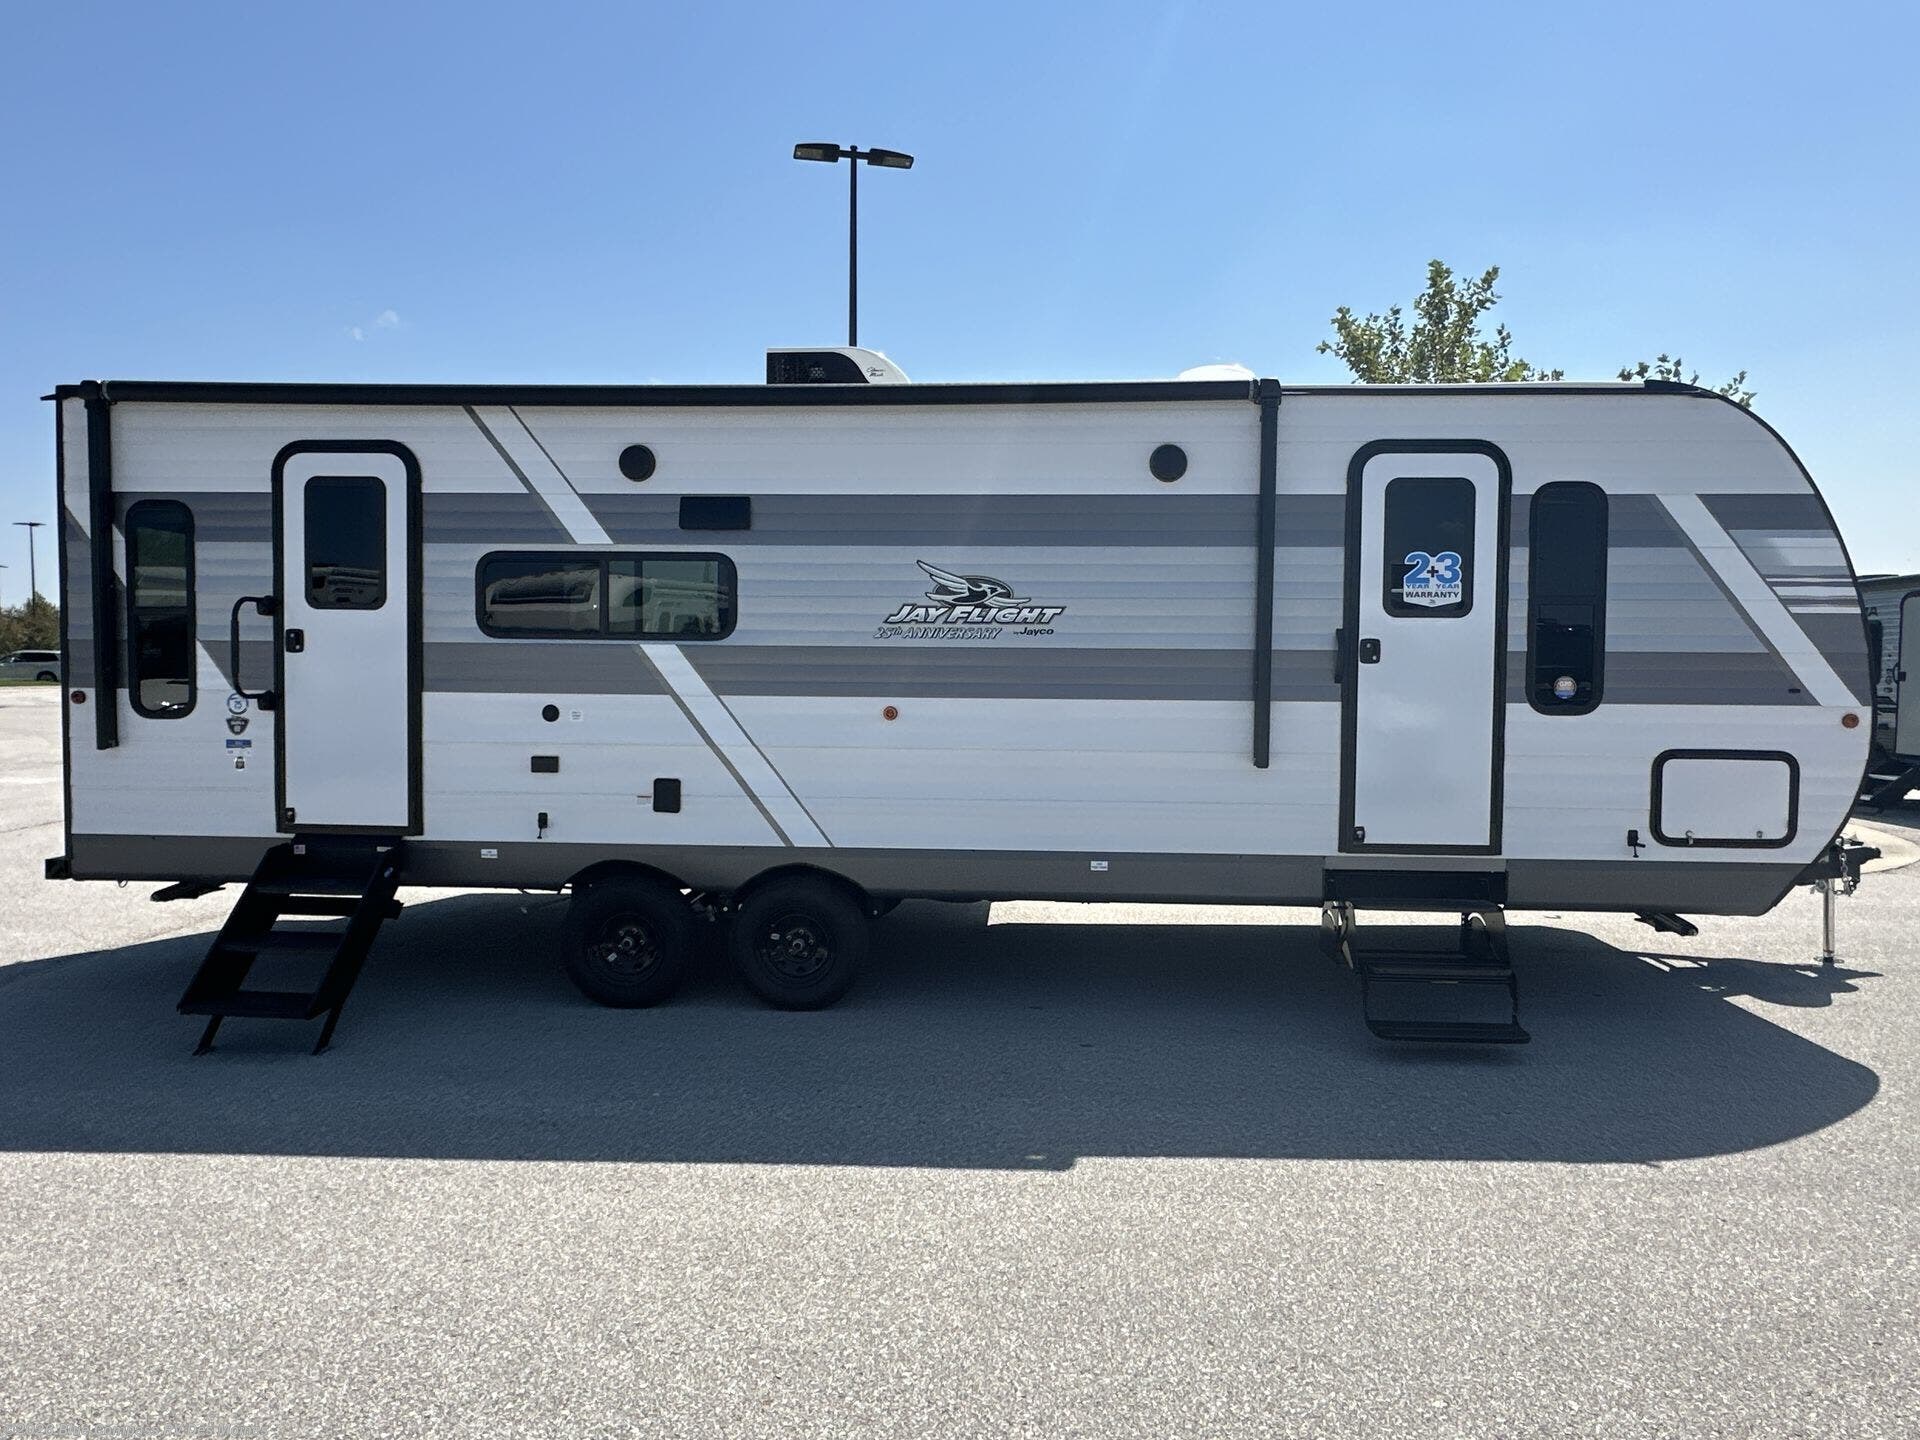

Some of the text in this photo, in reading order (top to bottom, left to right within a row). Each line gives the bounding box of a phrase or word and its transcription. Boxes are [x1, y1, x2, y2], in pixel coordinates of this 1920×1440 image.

[884, 603, 1066, 625] JAY FLIGHT
[902, 626, 1003, 640] ANNIVERSARY
[1020, 627, 1054, 636] Jayco
